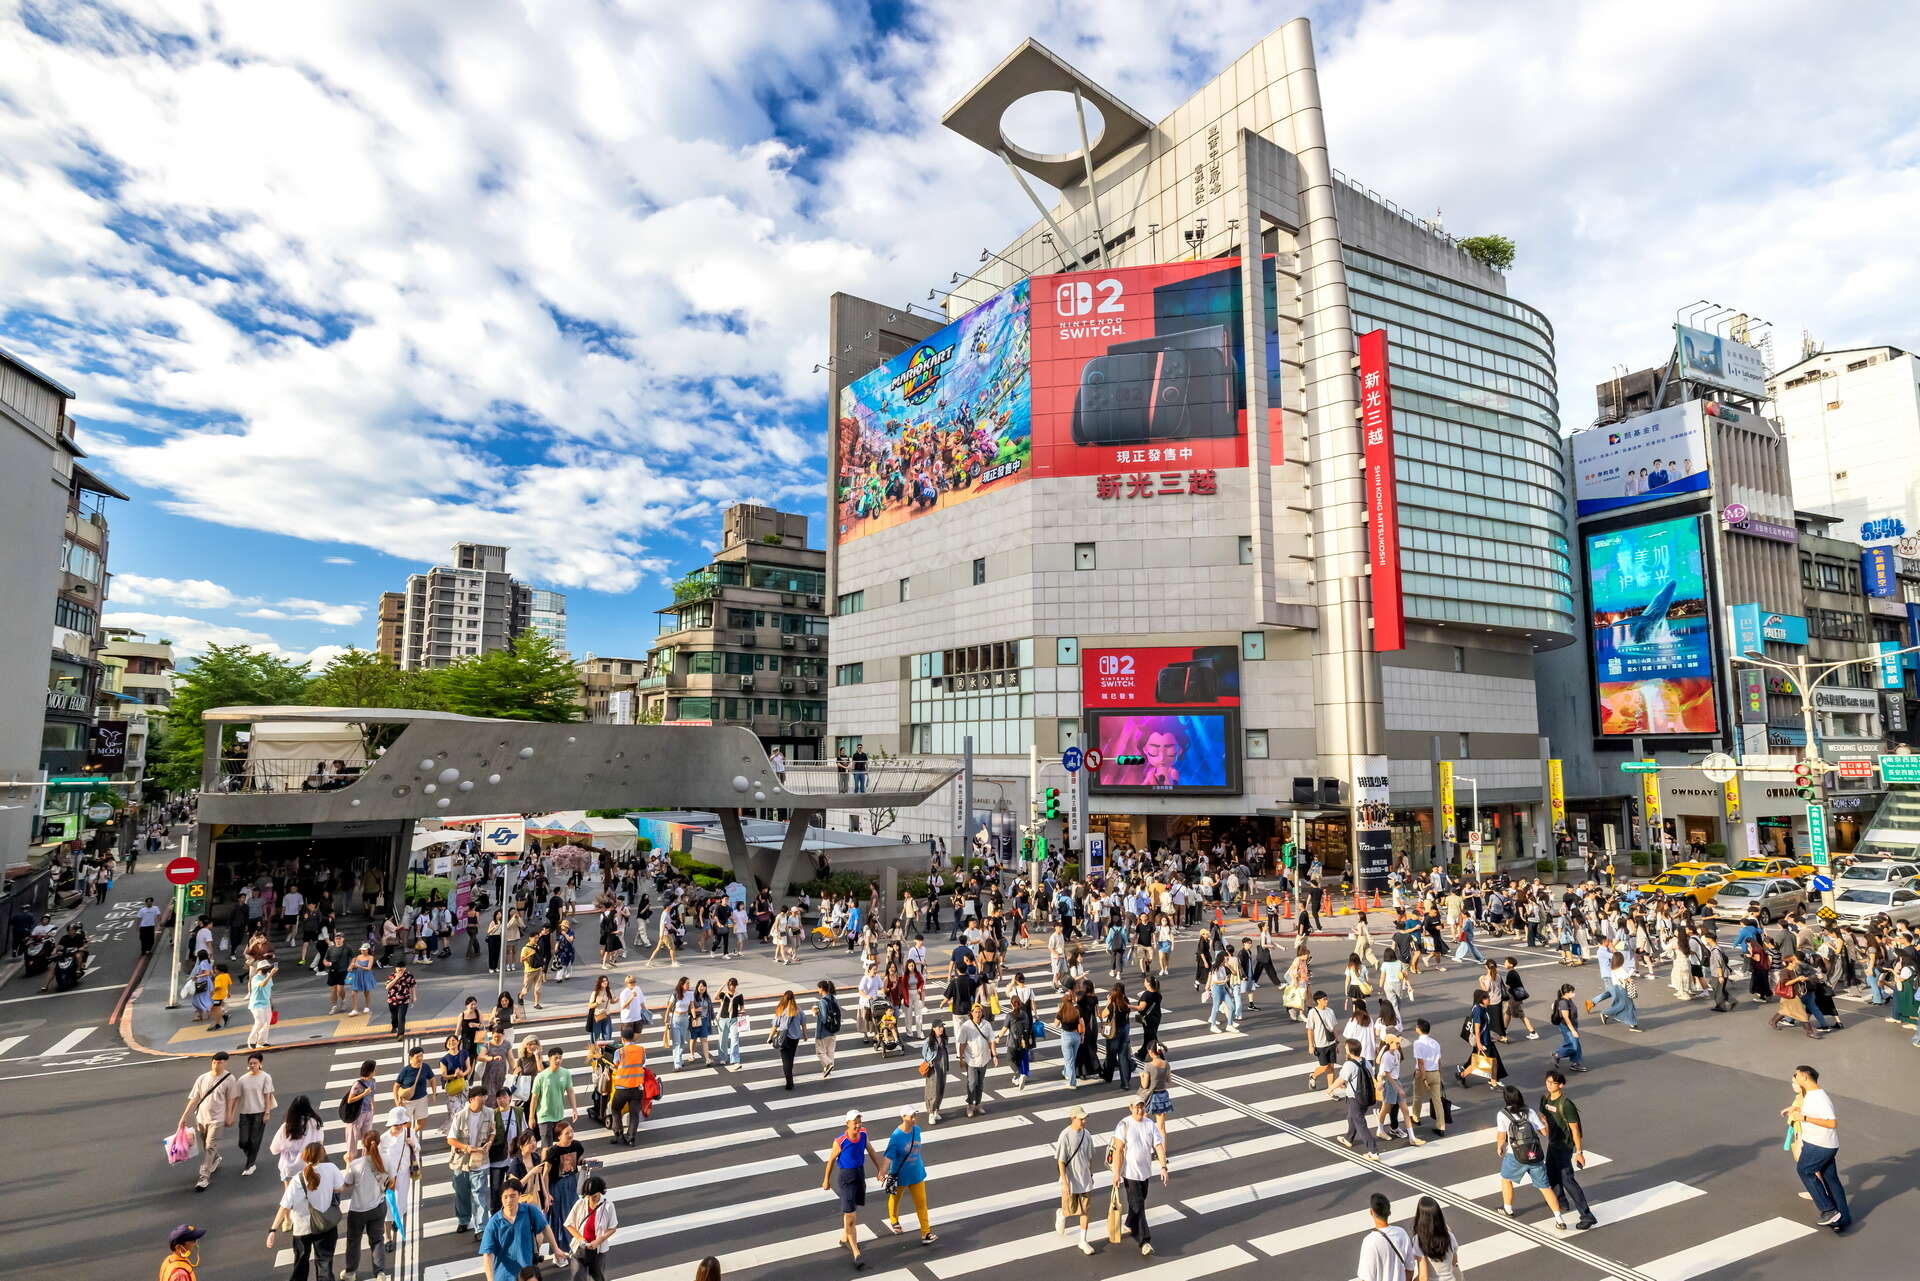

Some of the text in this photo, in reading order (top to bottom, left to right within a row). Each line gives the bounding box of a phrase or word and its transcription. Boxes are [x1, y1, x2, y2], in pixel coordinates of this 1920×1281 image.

[1096, 279, 1124, 313] 2
[1060, 317, 1122, 328] NINTENDO
[1060, 325, 1123, 340] SWITCH
[891, 343, 956, 391] MARIO KART
[1365, 371, 1384, 446] 新光三越
[1116, 447, 1193, 464] 現正發售中
[982, 460, 1021, 483] 現正發售中
[1374, 465, 1382, 486] SHIN
[1096, 469, 1218, 499] 新光三越
[1377, 512, 1386, 566] MITSUKOSHI
[1100, 680, 1134, 688] SWITCH
[69, 694, 86, 711] HAIR
[1671, 788, 1718, 796] OWNDAYS
[190, 884, 204, 897] 25
